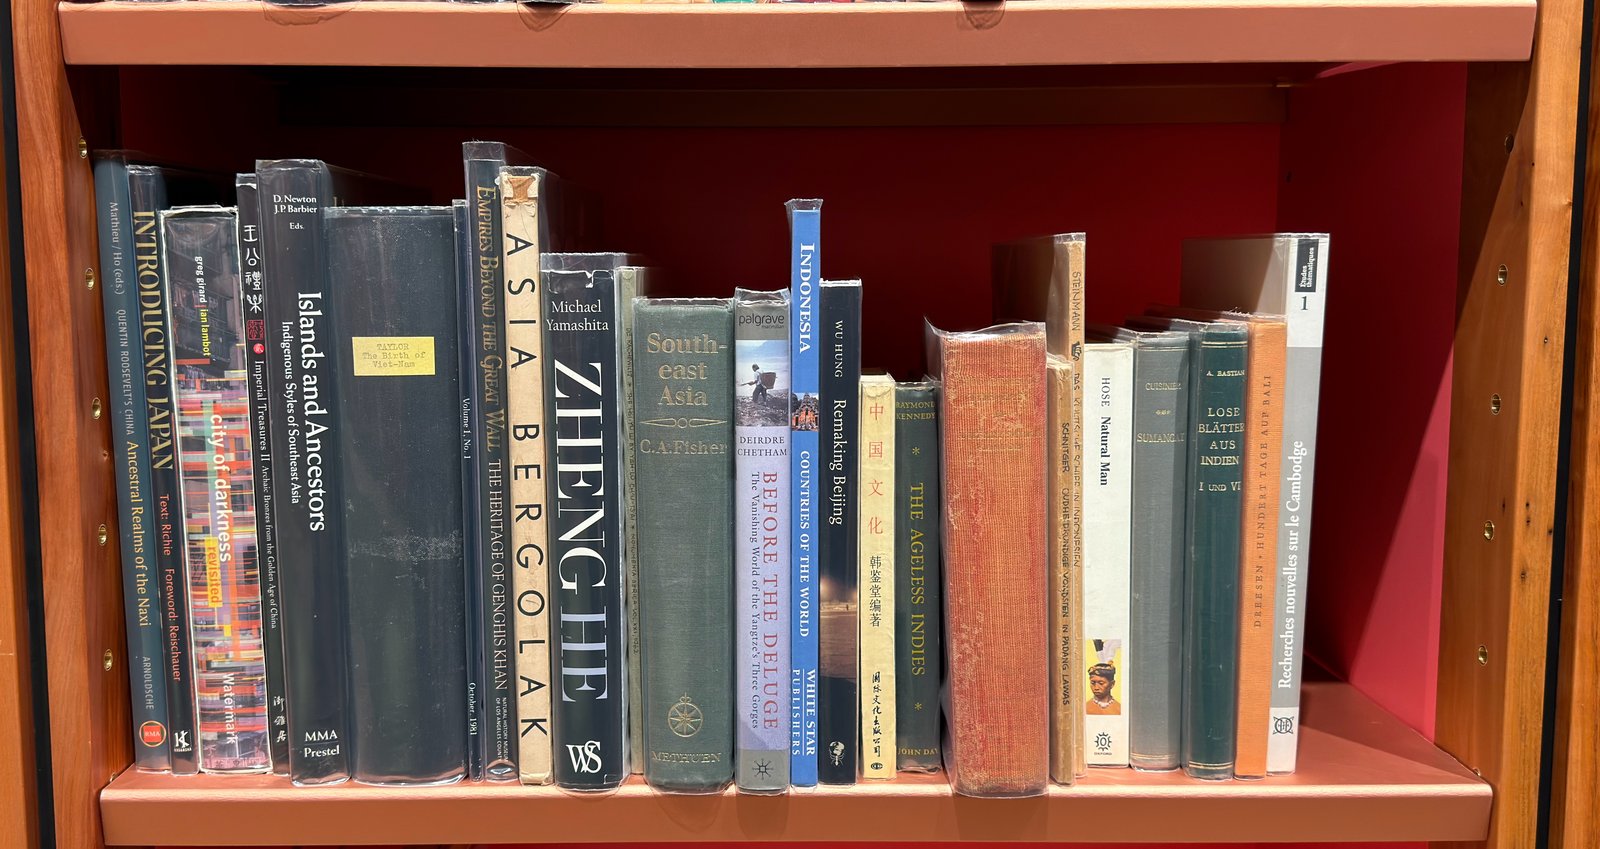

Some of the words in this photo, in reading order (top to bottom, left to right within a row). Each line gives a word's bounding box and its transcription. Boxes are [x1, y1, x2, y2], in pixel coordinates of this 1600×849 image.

[273, 194, 283, 203] D.
[284, 194, 317, 203] Newton
[274, 204, 286, 215] J.P.
[287, 205, 318, 214] Barbier
[110, 202, 121, 243] Mathieu
[289, 222, 304, 230] Eds.
[477, 186, 497, 252] EMPIRES
[113, 252, 123, 266] Ho
[195, 256, 203, 276] greg
[113, 268, 125, 295] (eds.)
[197, 278, 207, 303] girard
[479, 255, 499, 317] BEYOND
[133, 211, 167, 385] INTRODUCING
[506, 233, 537, 368] ASIA
[552, 299, 602, 313] Michael
[799, 243, 815, 353] INDONESIA
[1071, 271, 1082, 331] STEINMANN
[1301, 296, 1309, 310] 1
[200, 309, 209, 323] ian
[298, 292, 325, 369] Islands
[546, 318, 609, 331] Yamashita
[738, 313, 785, 327] palgrave
[834, 320, 843, 339] WU
[201, 324, 211, 357] lambot
[280, 321, 295, 380] Indigenous
[376, 343, 409, 351] TAYLOR
[482, 321, 497, 351] THE
[647, 332, 727, 354] South-
[362, 352, 378, 360] The
[382, 352, 409, 360] Birth
[414, 351, 426, 359] of
[372, 361, 415, 369] Viet-Nam
[658, 362, 708, 380] east
[834, 344, 843, 378] HUNG
[116, 309, 128, 347] QUENTIN
[124, 409, 135, 435] CHINA
[253, 360, 266, 401] Imperial
[481, 355, 503, 405] GREAT
[1216, 369, 1245, 378] BASTIAN
[283, 382, 298, 414] Styles
[302, 375, 328, 416] and
[658, 385, 708, 406] Asia
[1101, 377, 1111, 407] HOSE
[1262, 375, 1271, 405] BALI
[257, 403, 270, 451] Treasures
[288, 415, 299, 428] of
[1207, 407, 1241, 417] LOSE
[1261, 412, 1269, 436] AUF
[146, 397, 173, 470] JAPAN
[208, 414, 227, 447] city
[486, 408, 504, 453] WALL
[739, 436, 785, 444] DEIRDRE
[828, 399, 847, 471] Remaking
[1100, 416, 1111, 458] Natural
[1209, 440, 1236, 450] AUS
[213, 454, 231, 472] of
[261, 454, 270, 462] II
[289, 429, 301, 481] Southeast
[737, 448, 787, 456] CHETHAM
[1062, 422, 1070, 473] SCHNITGER
[1200, 455, 1240, 466] INDIEN
[1260, 443, 1268, 478] TAGE
[126, 441, 144, 502] Ancestral
[262, 465, 271, 493] Archaic
[305, 420, 329, 532] Ancestors
[488, 459, 502, 488] THE
[555, 358, 607, 595] ZHENG
[751, 472, 760, 491] The
[868, 402, 884, 535] 中国文化
[1100, 462, 1111, 486] Man
[1286, 440, 1307, 512] Cambodge
[291, 483, 303, 504] Asia
[800, 450, 810, 529] COUNTRIES
[828, 476, 847, 525] Beijing
[910, 482, 924, 520] THE
[1198, 481, 1204, 491] I
[159, 494, 170, 519] Text:
[214, 478, 233, 563] darkness
[264, 495, 273, 523] Bronzes
[750, 495, 760, 543] Vanishing
[763, 472, 778, 564] BEFORE
[1256, 484, 1266, 550] HUNDERT
[1284, 515, 1299, 527] le
[131, 507, 146, 552] Realms
[162, 524, 173, 556] Richie
[265, 525, 274, 541] from
[489, 490, 504, 559] HERITAGE
[267, 543, 275, 555] the
[800, 533, 810, 551] OF
[1288, 530, 1299, 552] sur
[135, 556, 148, 571] of
[207, 546, 222, 604] revisited
[268, 556, 277, 582] Golden
[491, 562, 505, 582] OF
[751, 547, 760, 576] World
[800, 555, 810, 583] THE
[910, 528, 925, 604] AGELESS
[137, 573, 149, 594] the
[165, 568, 178, 621] Foreword:
[268, 584, 278, 597] Age
[513, 424, 547, 738] BERGOLAK
[751, 580, 761, 591] of
[869, 556, 882, 628] 韩鉴堂编著
[1282, 554, 1297, 614] nouvelles
[138, 598, 152, 627] Naxi
[491, 583, 507, 646] GENGHIS
[751, 594, 760, 609] the
[763, 574, 778, 623] THE
[800, 587, 810, 637] WORLD
[270, 608, 279, 628] China
[1062, 624, 1069, 633] IN
[750, 613, 760, 658] Yangtze's
[911, 614, 925, 675] INDIES
[169, 625, 182, 682] Reischauer
[560, 606, 608, 703] HE
[1062, 636, 1070, 671] PADANG
[1278, 617, 1295, 688] Recherches
[142, 656, 155, 709] ARNOLDSCHE
[493, 650, 508, 690] KHAN
[751, 662, 761, 690] Three
[763, 633, 778, 729] DELUGE
[806, 669, 816, 716] WHITE
[1062, 674, 1070, 706] LAWAS
[222, 673, 239, 744] Watermark
[750, 695, 761, 729] Gorges
[792, 669, 800, 755] PUBLISHERS
[304, 729, 338, 742] MMA
[469, 717, 478, 736] 1981
[806, 721, 816, 755] STAR
[304, 744, 340, 758] Prestel
[651, 751, 722, 763] METHUEN
